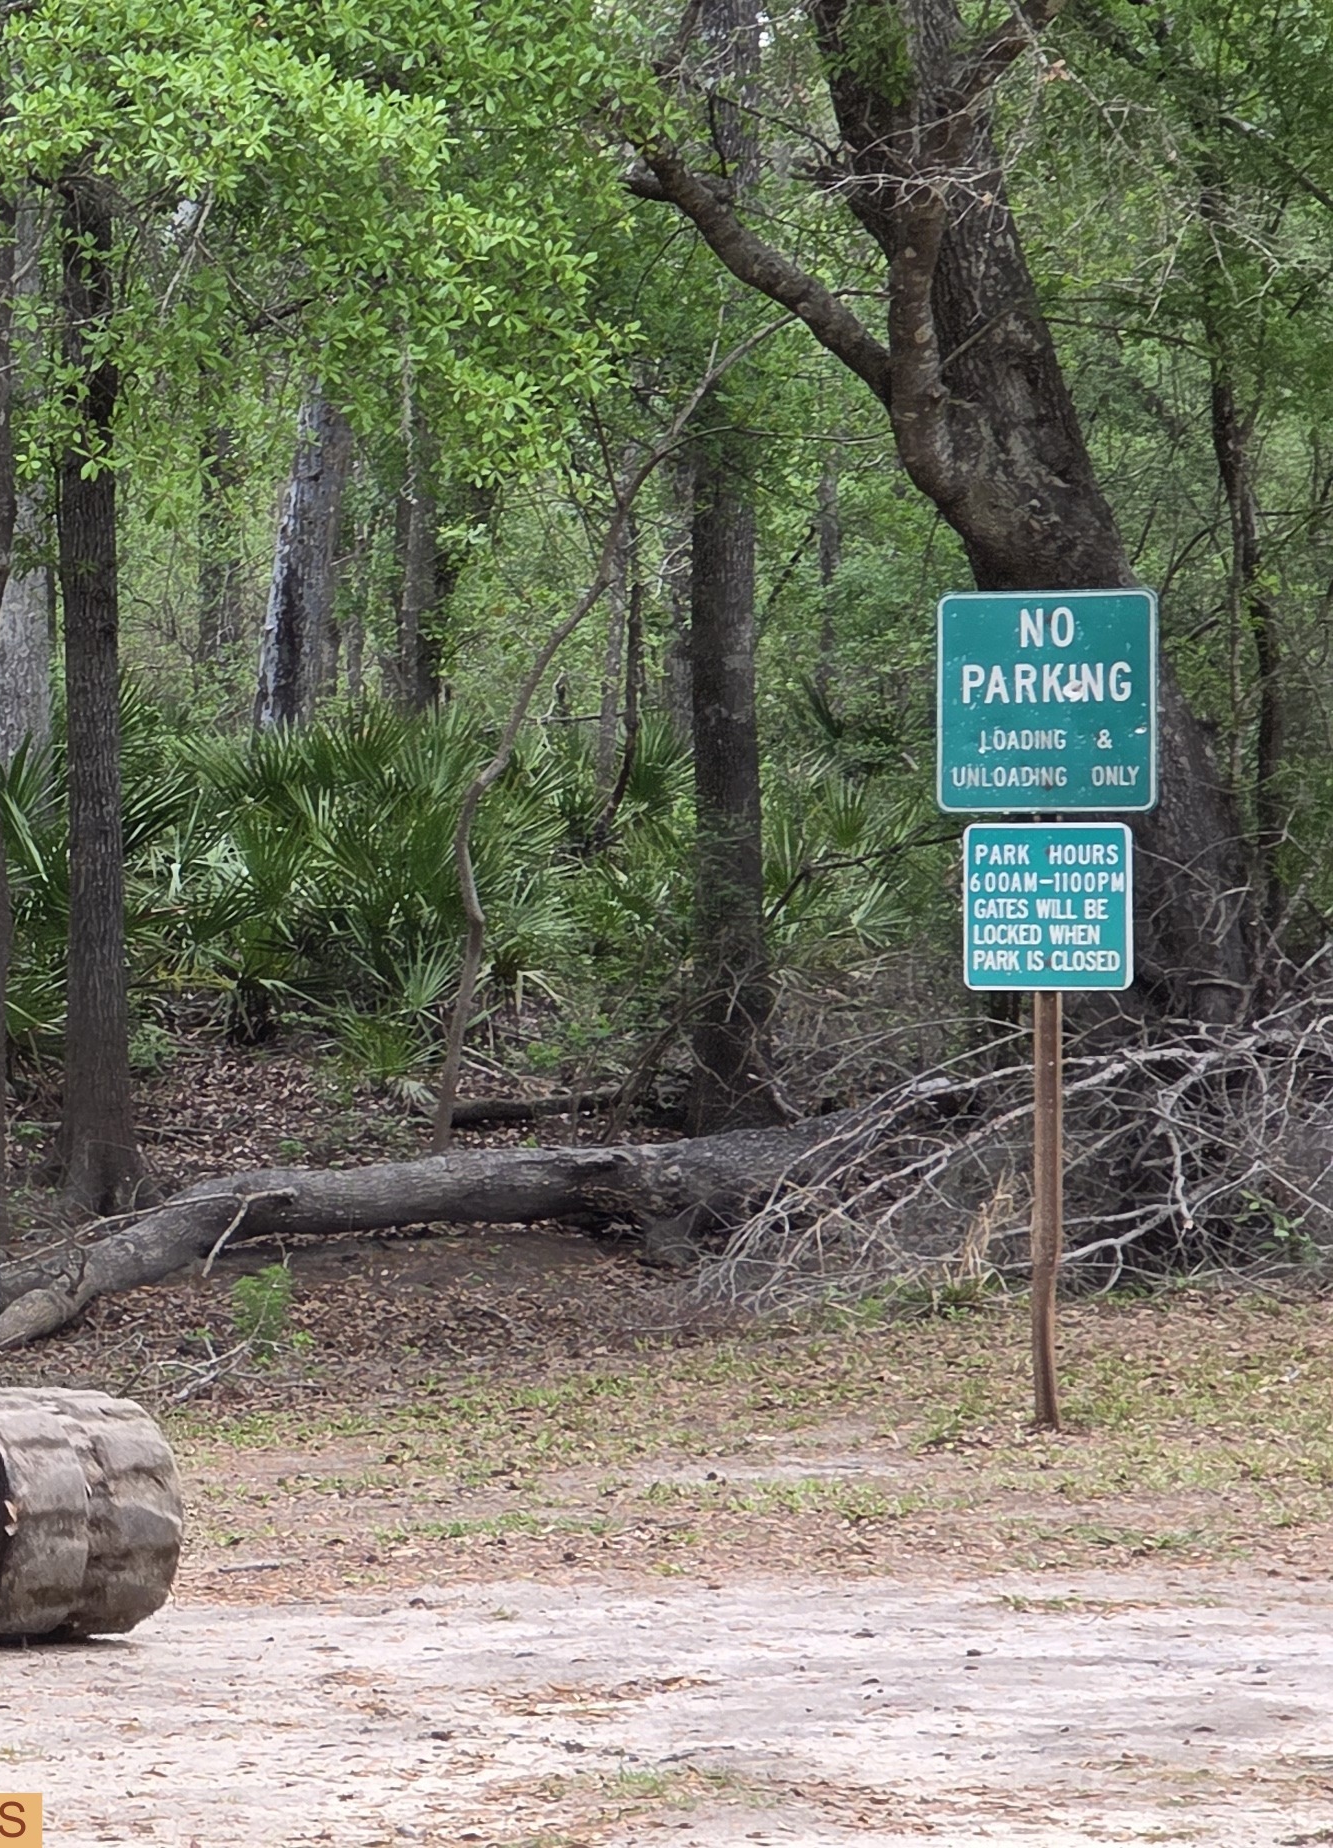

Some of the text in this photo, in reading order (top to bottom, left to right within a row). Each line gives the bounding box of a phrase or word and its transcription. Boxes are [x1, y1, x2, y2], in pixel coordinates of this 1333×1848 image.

[1019, 606, 1075, 648] NO
[961, 661, 1132, 704] PARKING
[979, 729, 1113, 752] LOADING &
[951, 765, 1139, 788] UNLOADING ONLY
[974, 843, 1119, 866] PARK HOURS
[974, 898, 1109, 920] GATES WILL BE
[973, 925, 1100, 946] LOCKED WHEN
[973, 950, 1120, 972] PARK IS CLOSED
